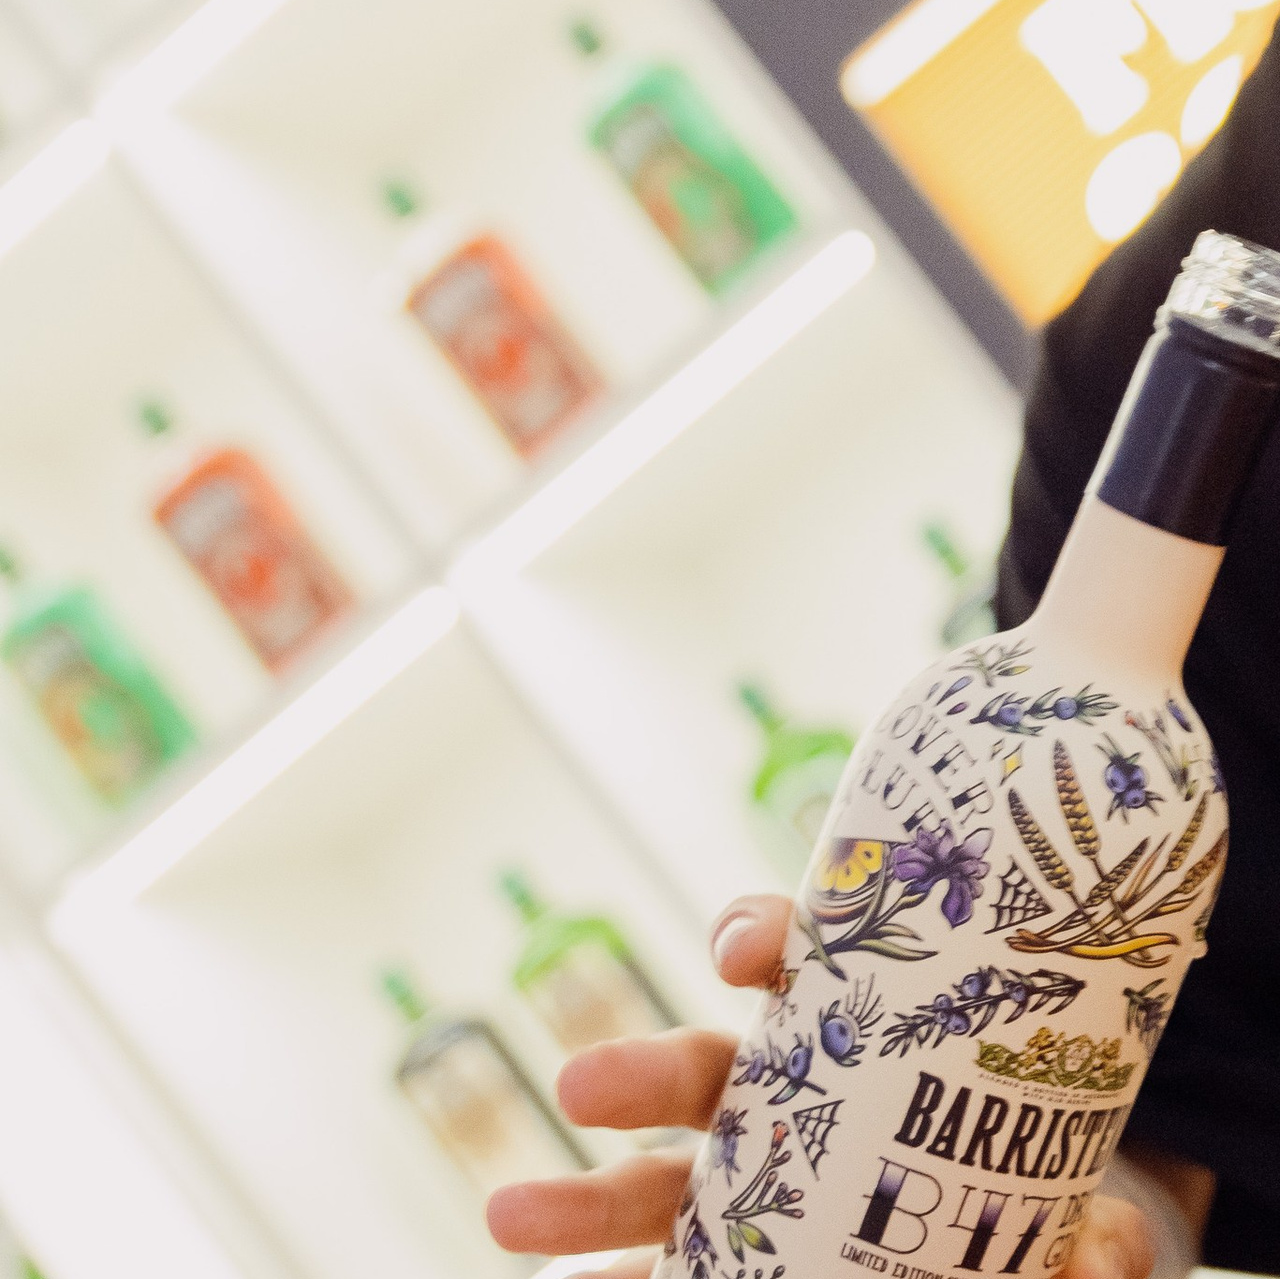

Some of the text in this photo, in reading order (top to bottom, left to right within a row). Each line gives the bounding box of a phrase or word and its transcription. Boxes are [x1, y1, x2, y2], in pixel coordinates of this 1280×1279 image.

[894, 1069, 1134, 1181] BARRISTE
[840, 1242, 889, 1273] LIMITED
[850, 1156, 1062, 1274] B47
